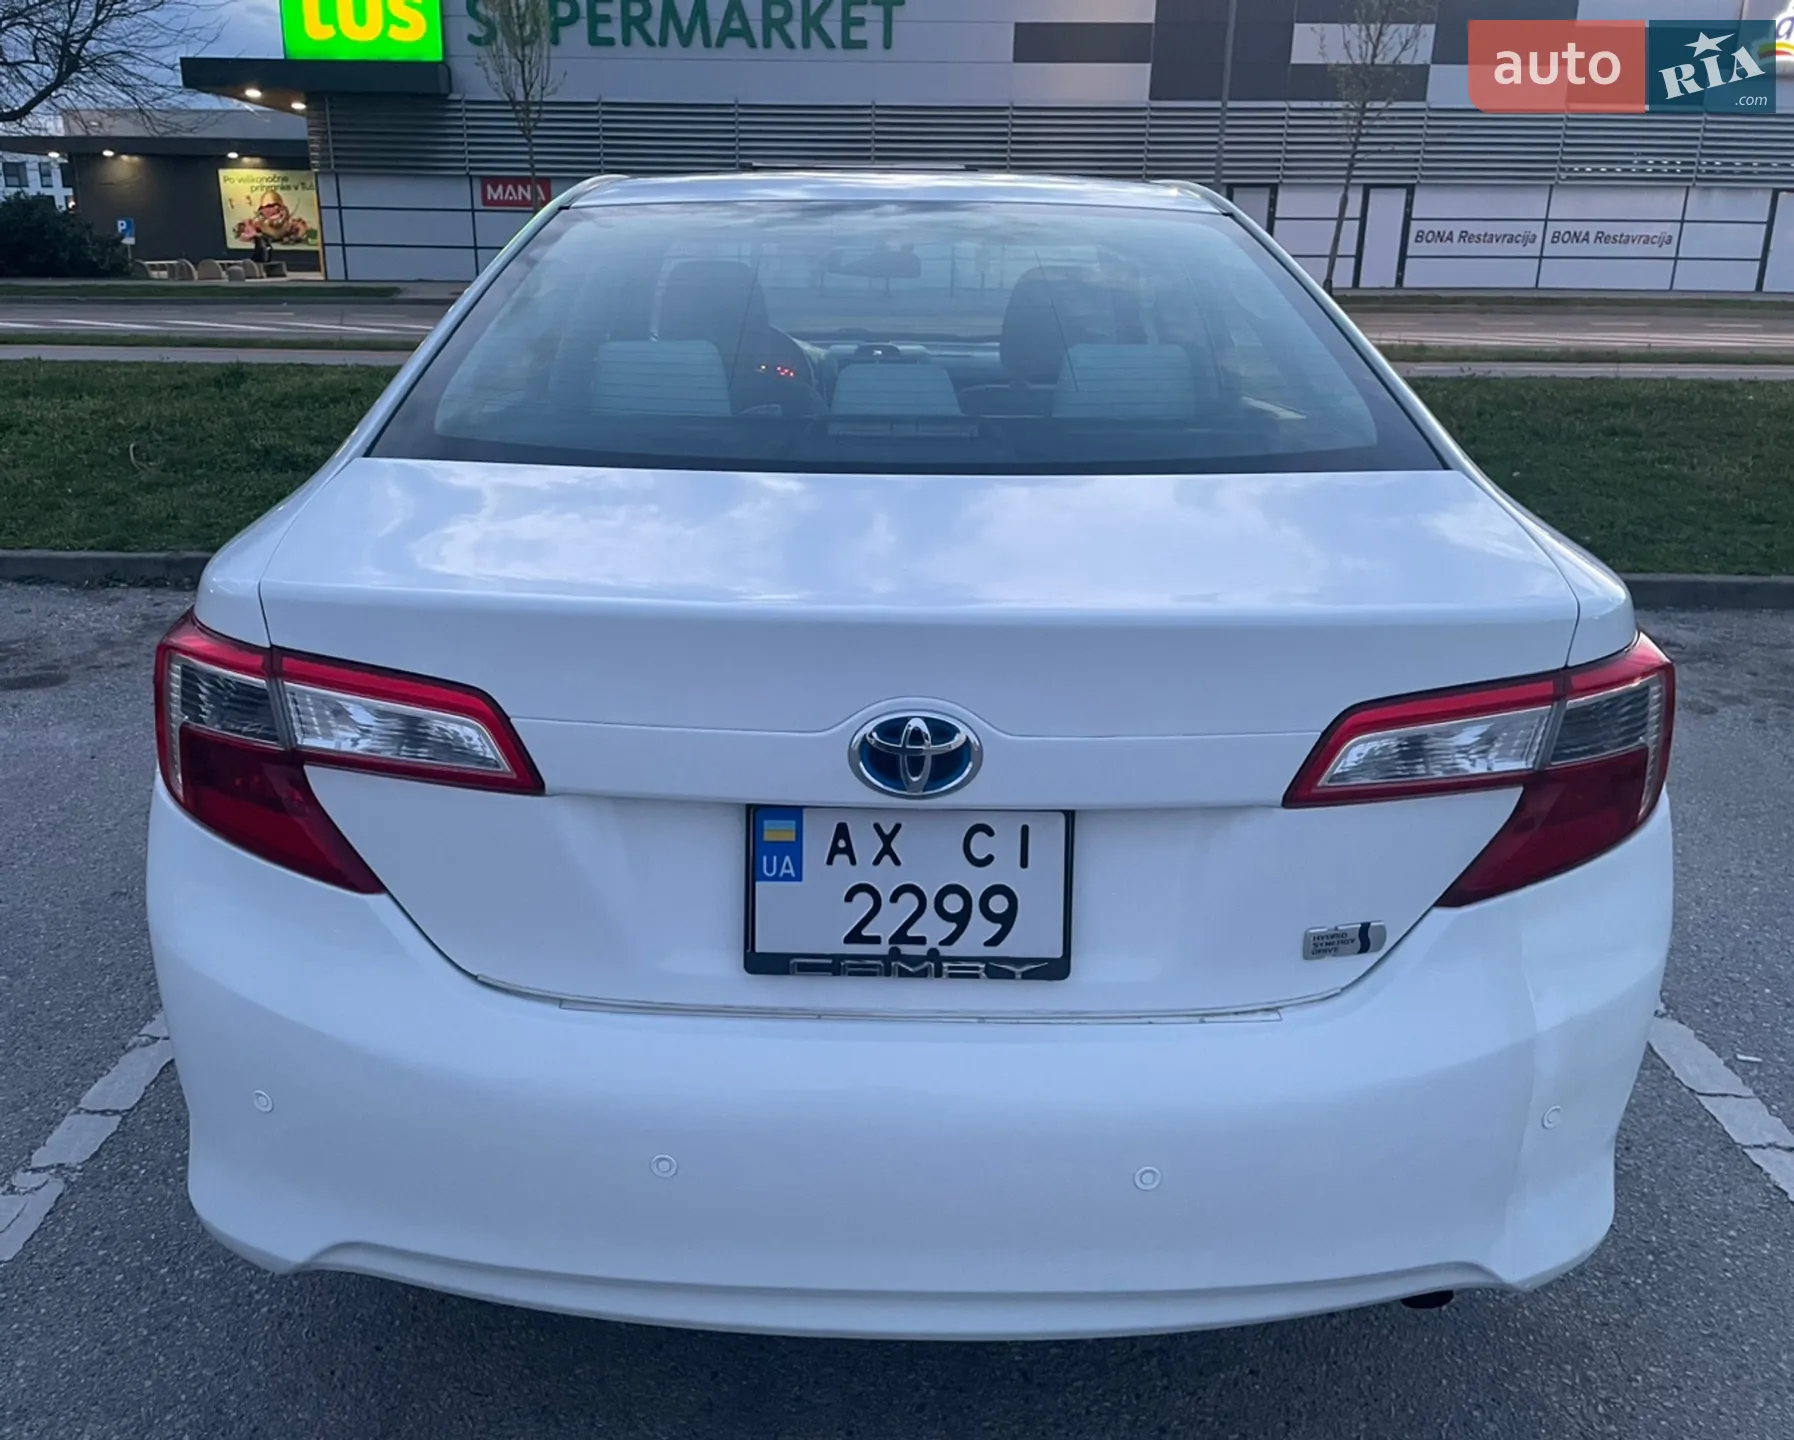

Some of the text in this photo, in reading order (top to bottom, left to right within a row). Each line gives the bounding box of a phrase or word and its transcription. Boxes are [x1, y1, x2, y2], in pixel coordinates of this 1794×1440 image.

[466, 0, 904, 49] SUPERMARKET
[117, 220, 127, 233] P
[1414, 229, 1538, 248] BONA Restavracija
[1550, 230, 1674, 248] BONA Restavracija
[826, 821, 1030, 869] AX CI
[762, 855, 796, 878] UA
[843, 882, 1019, 948] 2299
[789, 957, 1050, 979] CAMRY
